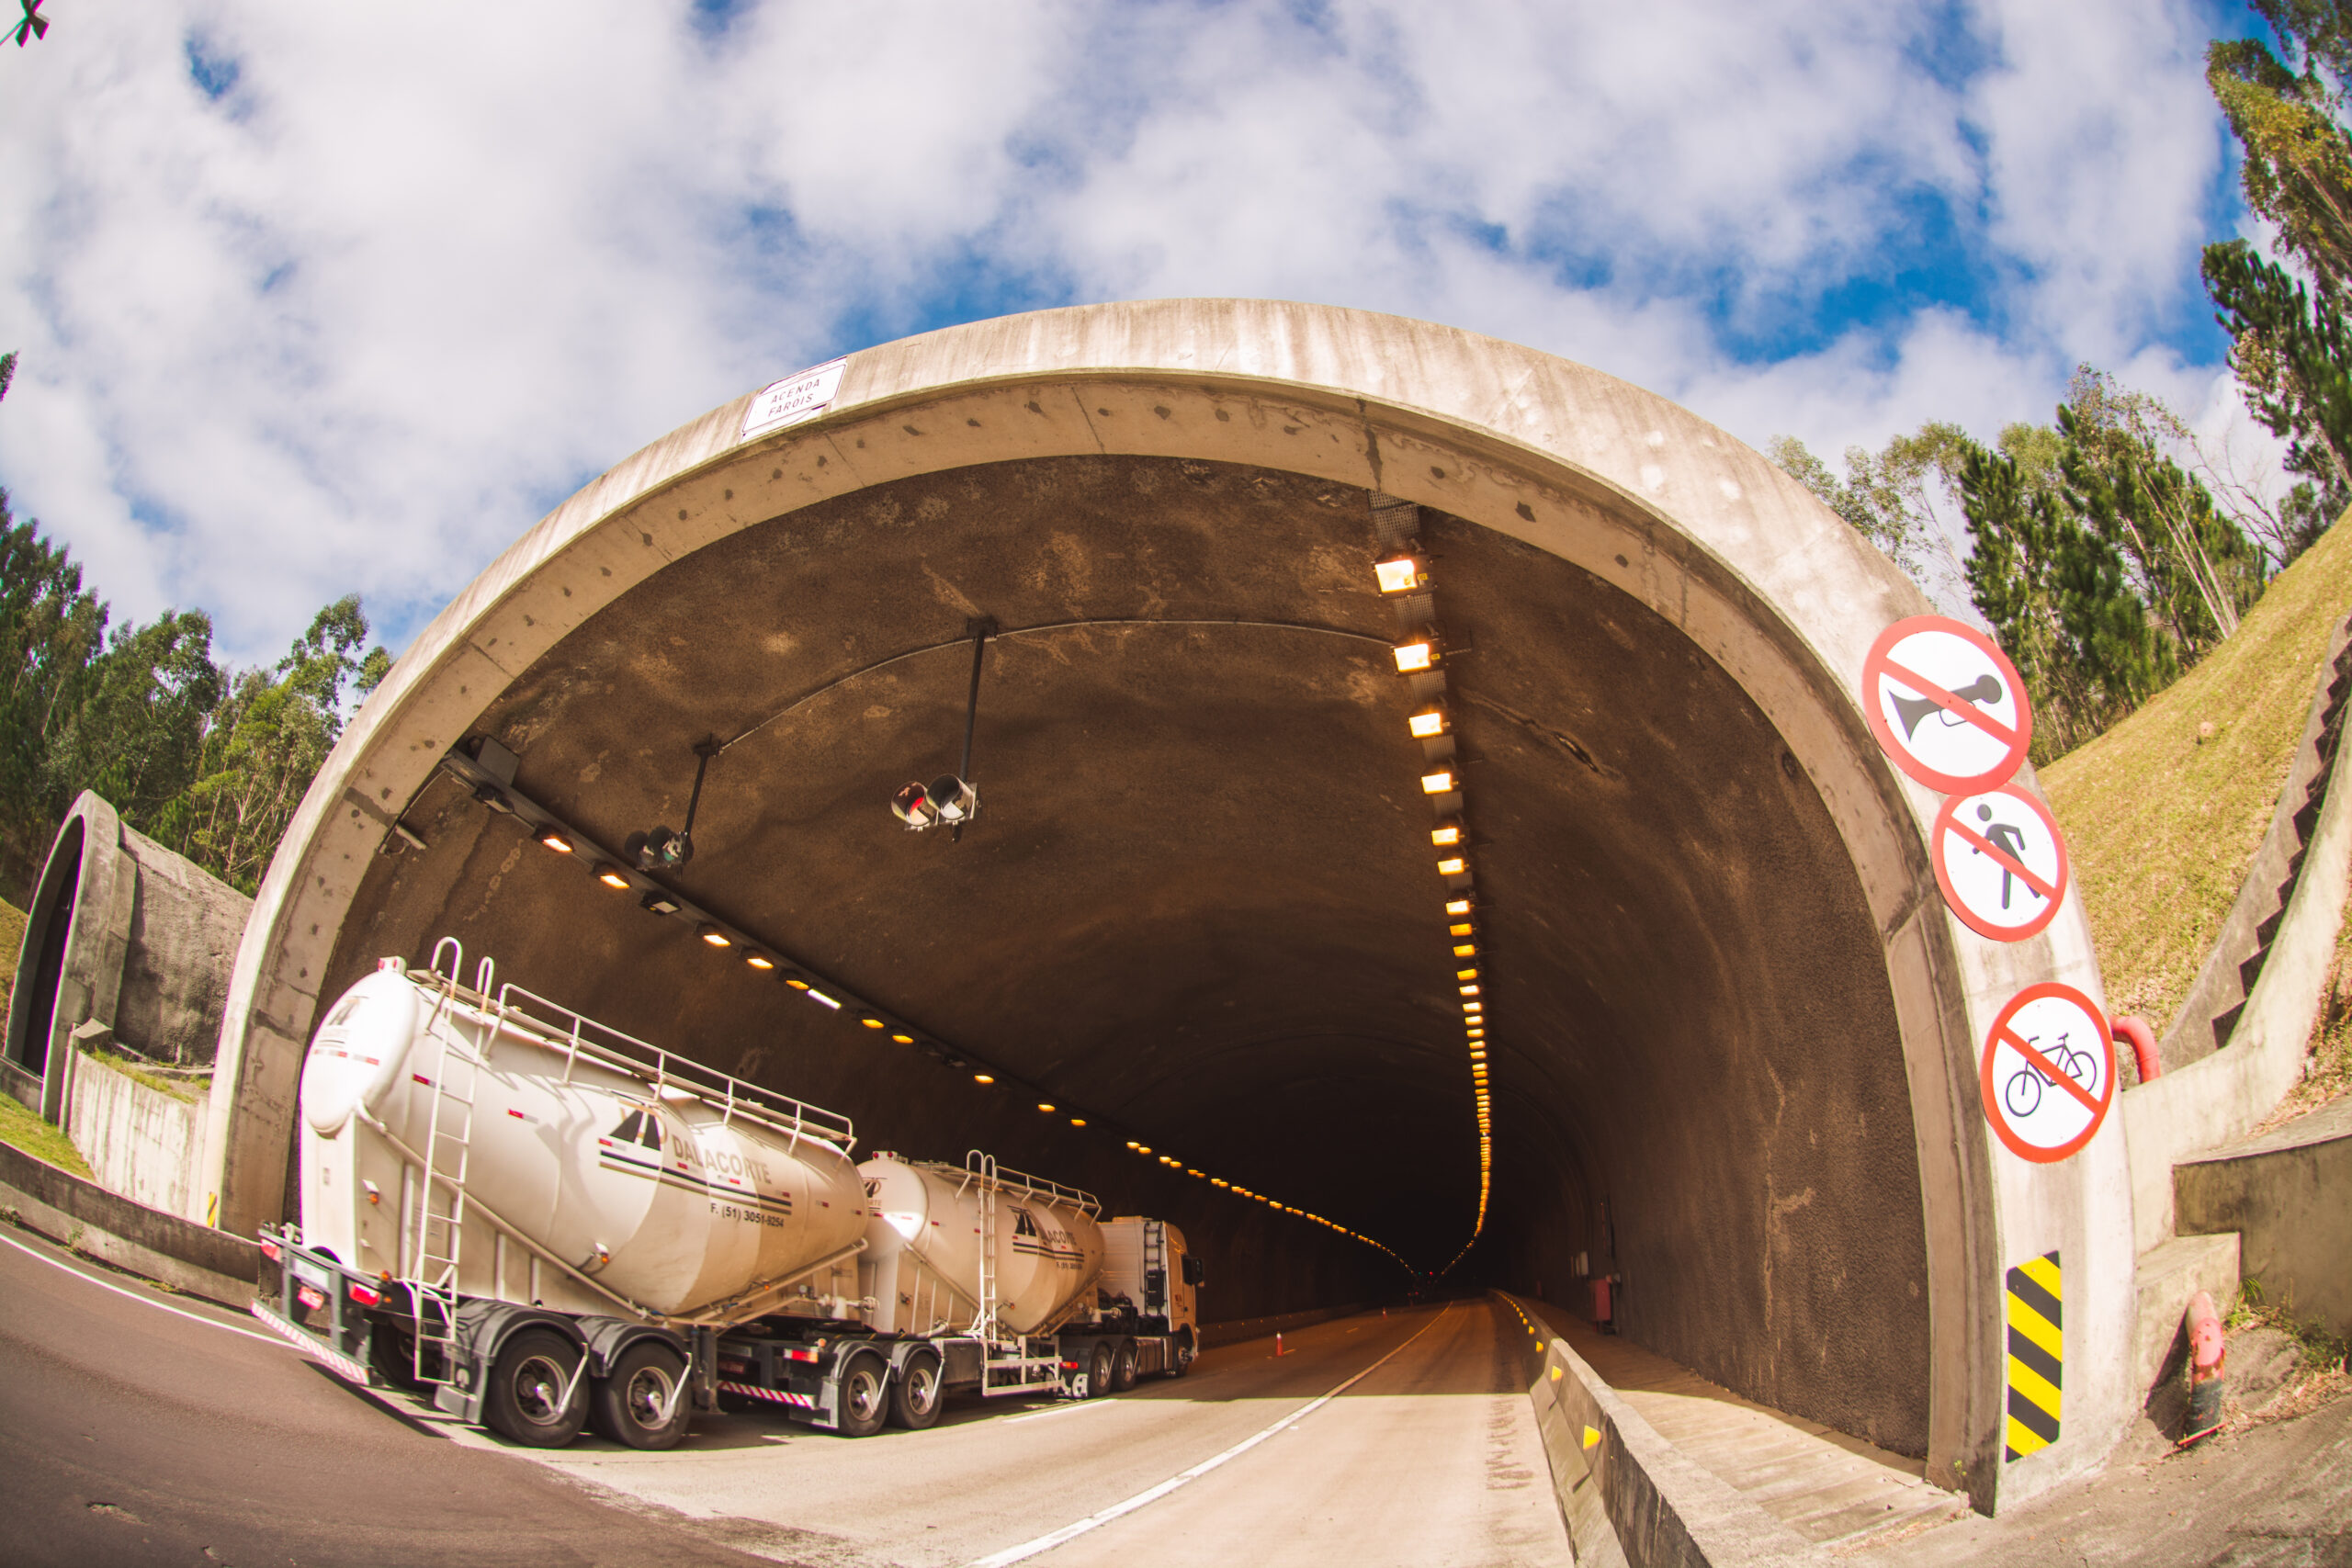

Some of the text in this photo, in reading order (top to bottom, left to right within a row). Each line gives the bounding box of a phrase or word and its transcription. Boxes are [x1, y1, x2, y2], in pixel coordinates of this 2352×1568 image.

[771, 378, 820, 404] ACENDA
[672, 1134, 772, 1184] DALACORTE
[721, 1207, 741, 1223] (51)
